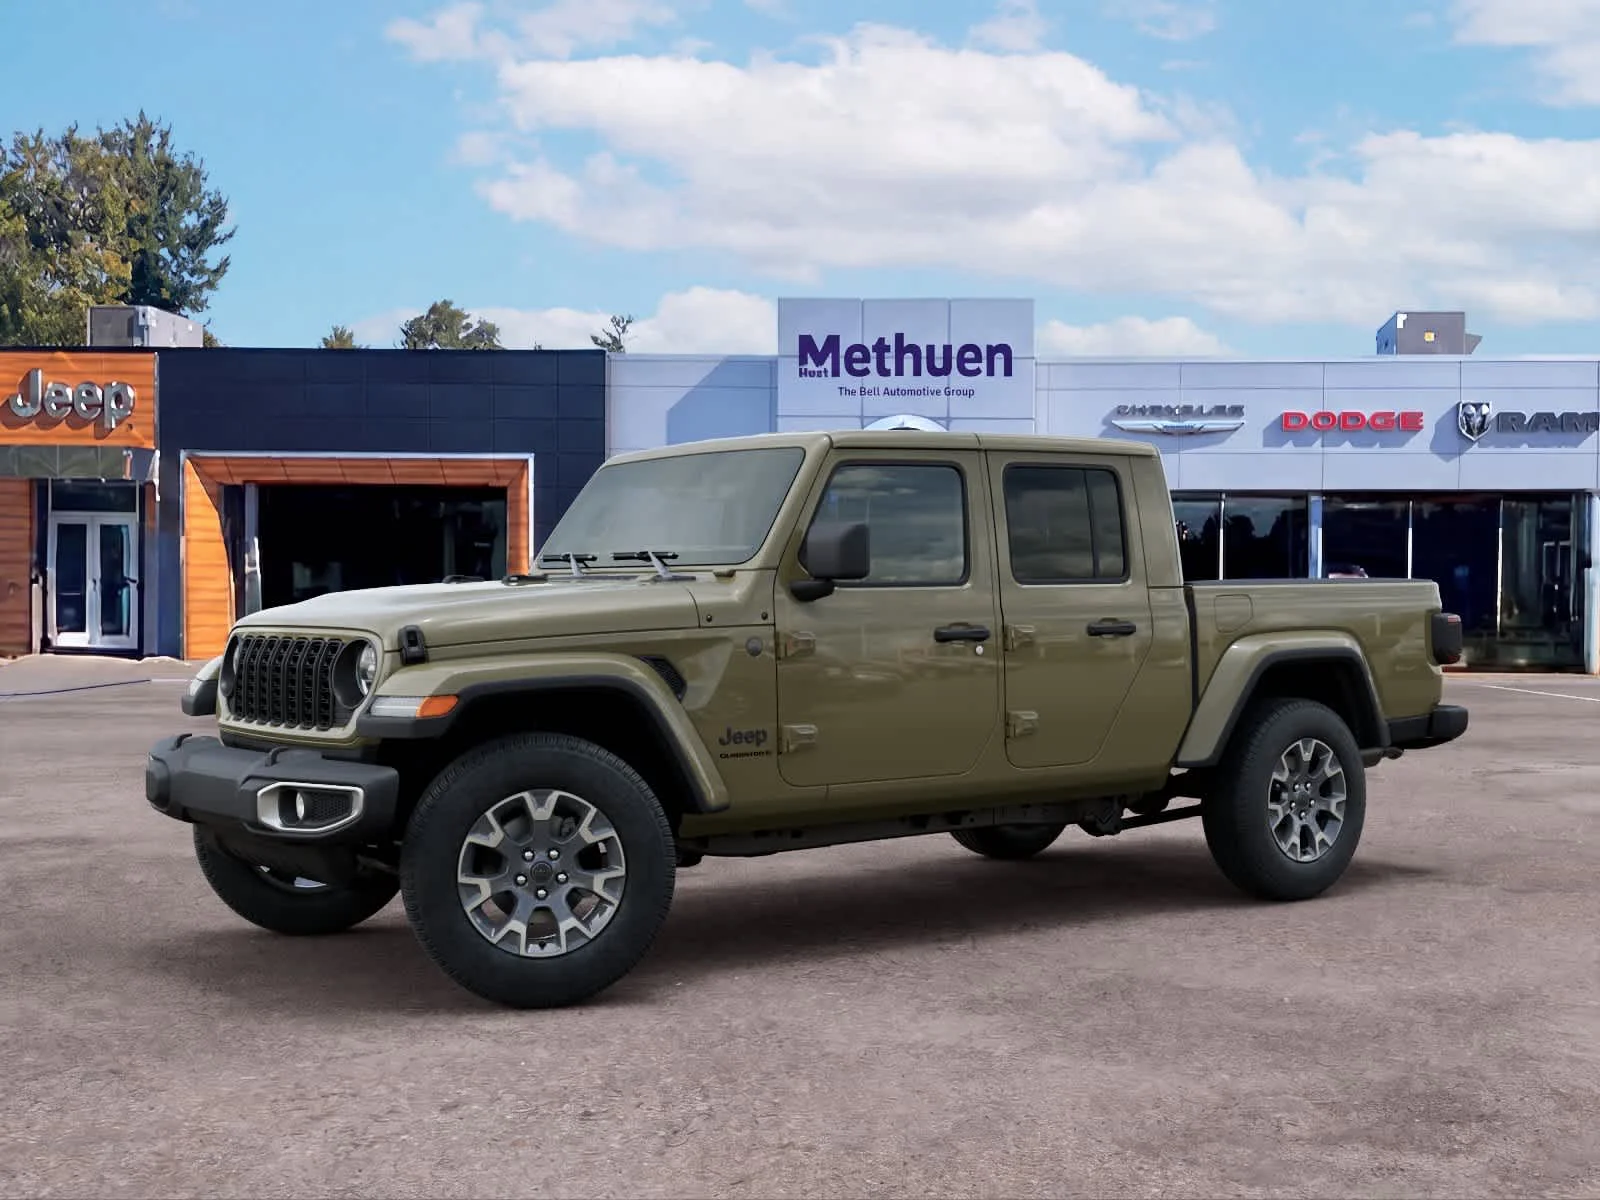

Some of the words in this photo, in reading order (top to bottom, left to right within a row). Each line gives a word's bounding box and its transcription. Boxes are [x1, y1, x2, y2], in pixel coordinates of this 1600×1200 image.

[798, 332, 1013, 378] Methuen
[9, 368, 136, 430] Jeep
[837, 386, 857, 397] The
[859, 386, 880, 397] Bell
[883, 386, 941, 397] Automotive
[944, 386, 975, 399] Group
[1282, 410, 1424, 432] DODGE
[1498, 411, 1599, 432] RAM
[718, 726, 768, 746] Jeep
